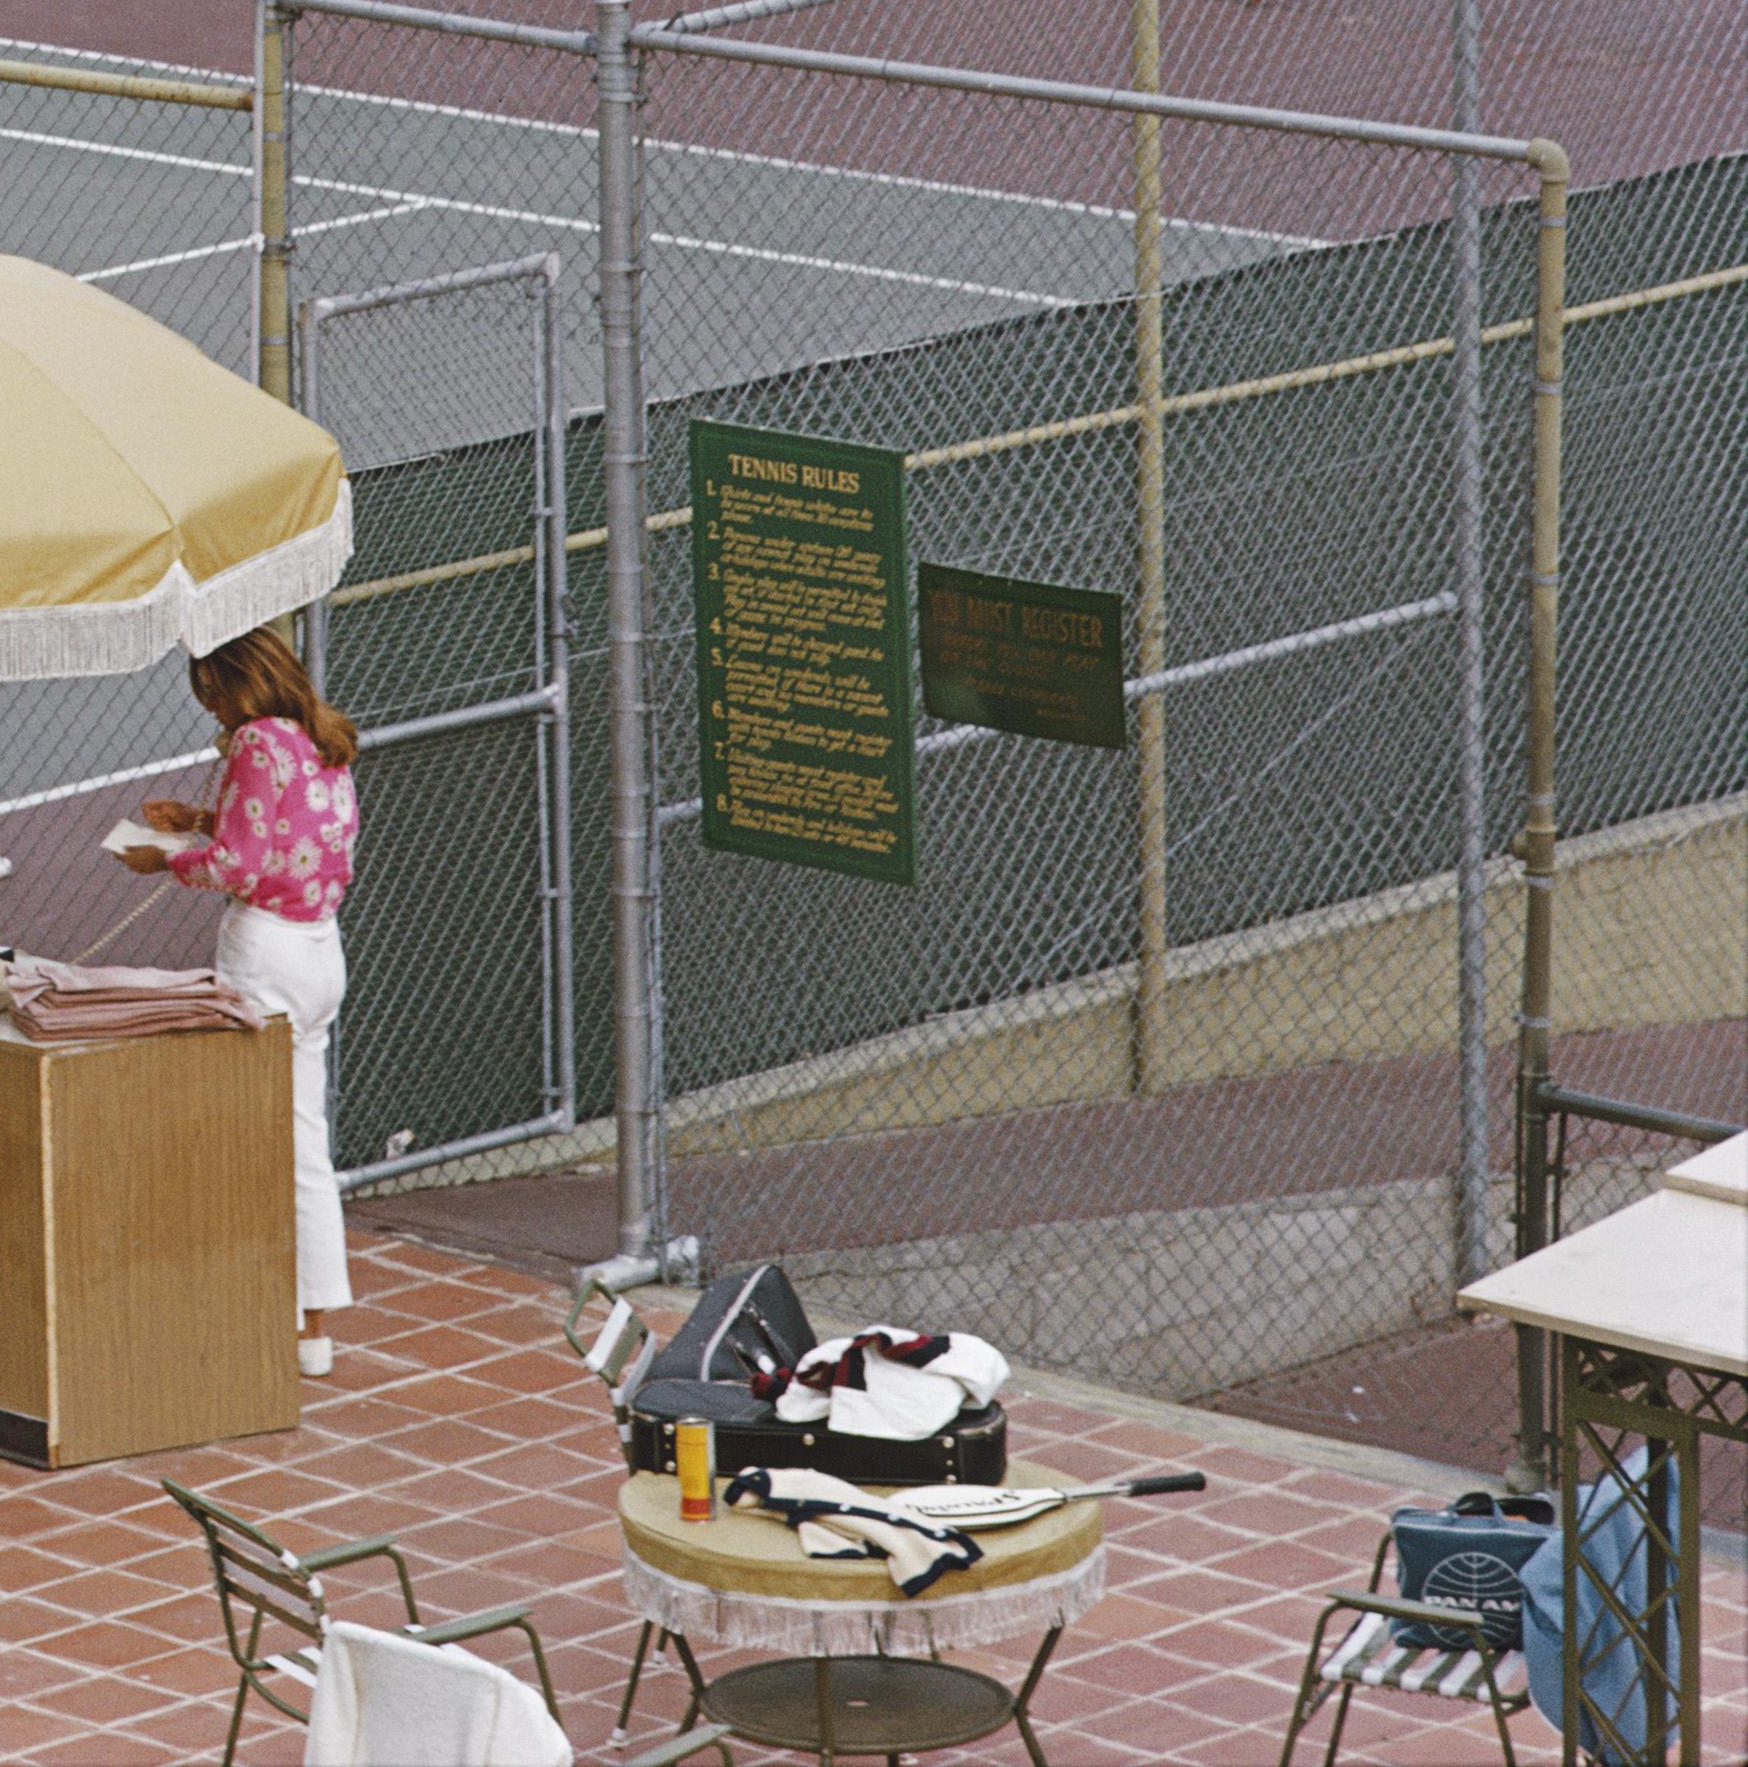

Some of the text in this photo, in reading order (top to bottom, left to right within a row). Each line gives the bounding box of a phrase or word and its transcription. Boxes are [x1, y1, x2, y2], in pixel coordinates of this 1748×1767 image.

[729, 454, 860, 494] TENNIS RULES
[706, 479, 716, 496] 1.
[707, 519, 719, 540] 2.
[710, 646, 723, 665] 5.
[712, 699, 724, 718] 6.
